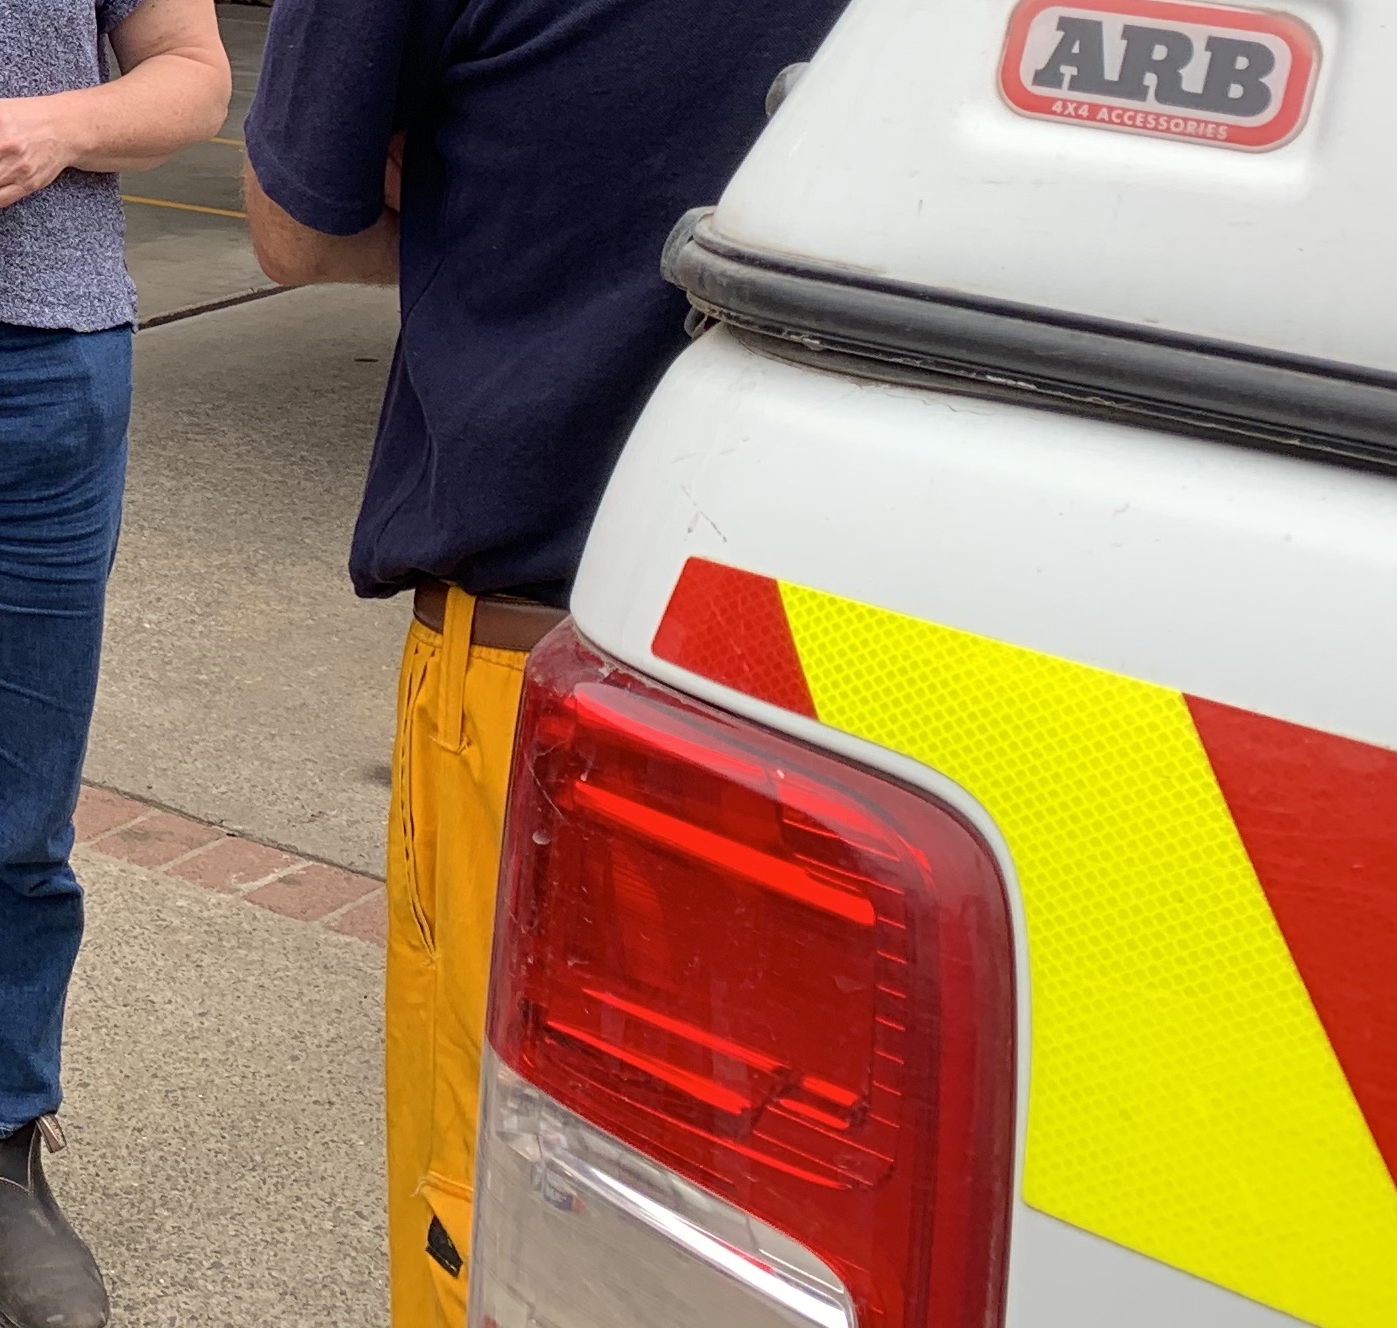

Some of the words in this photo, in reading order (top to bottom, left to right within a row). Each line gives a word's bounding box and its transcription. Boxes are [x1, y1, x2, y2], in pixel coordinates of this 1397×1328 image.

[1031, 15, 1276, 118] ARB
[1051, 101, 1089, 119] 4X4
[1096, 107, 1229, 140] ACCESSORIES
